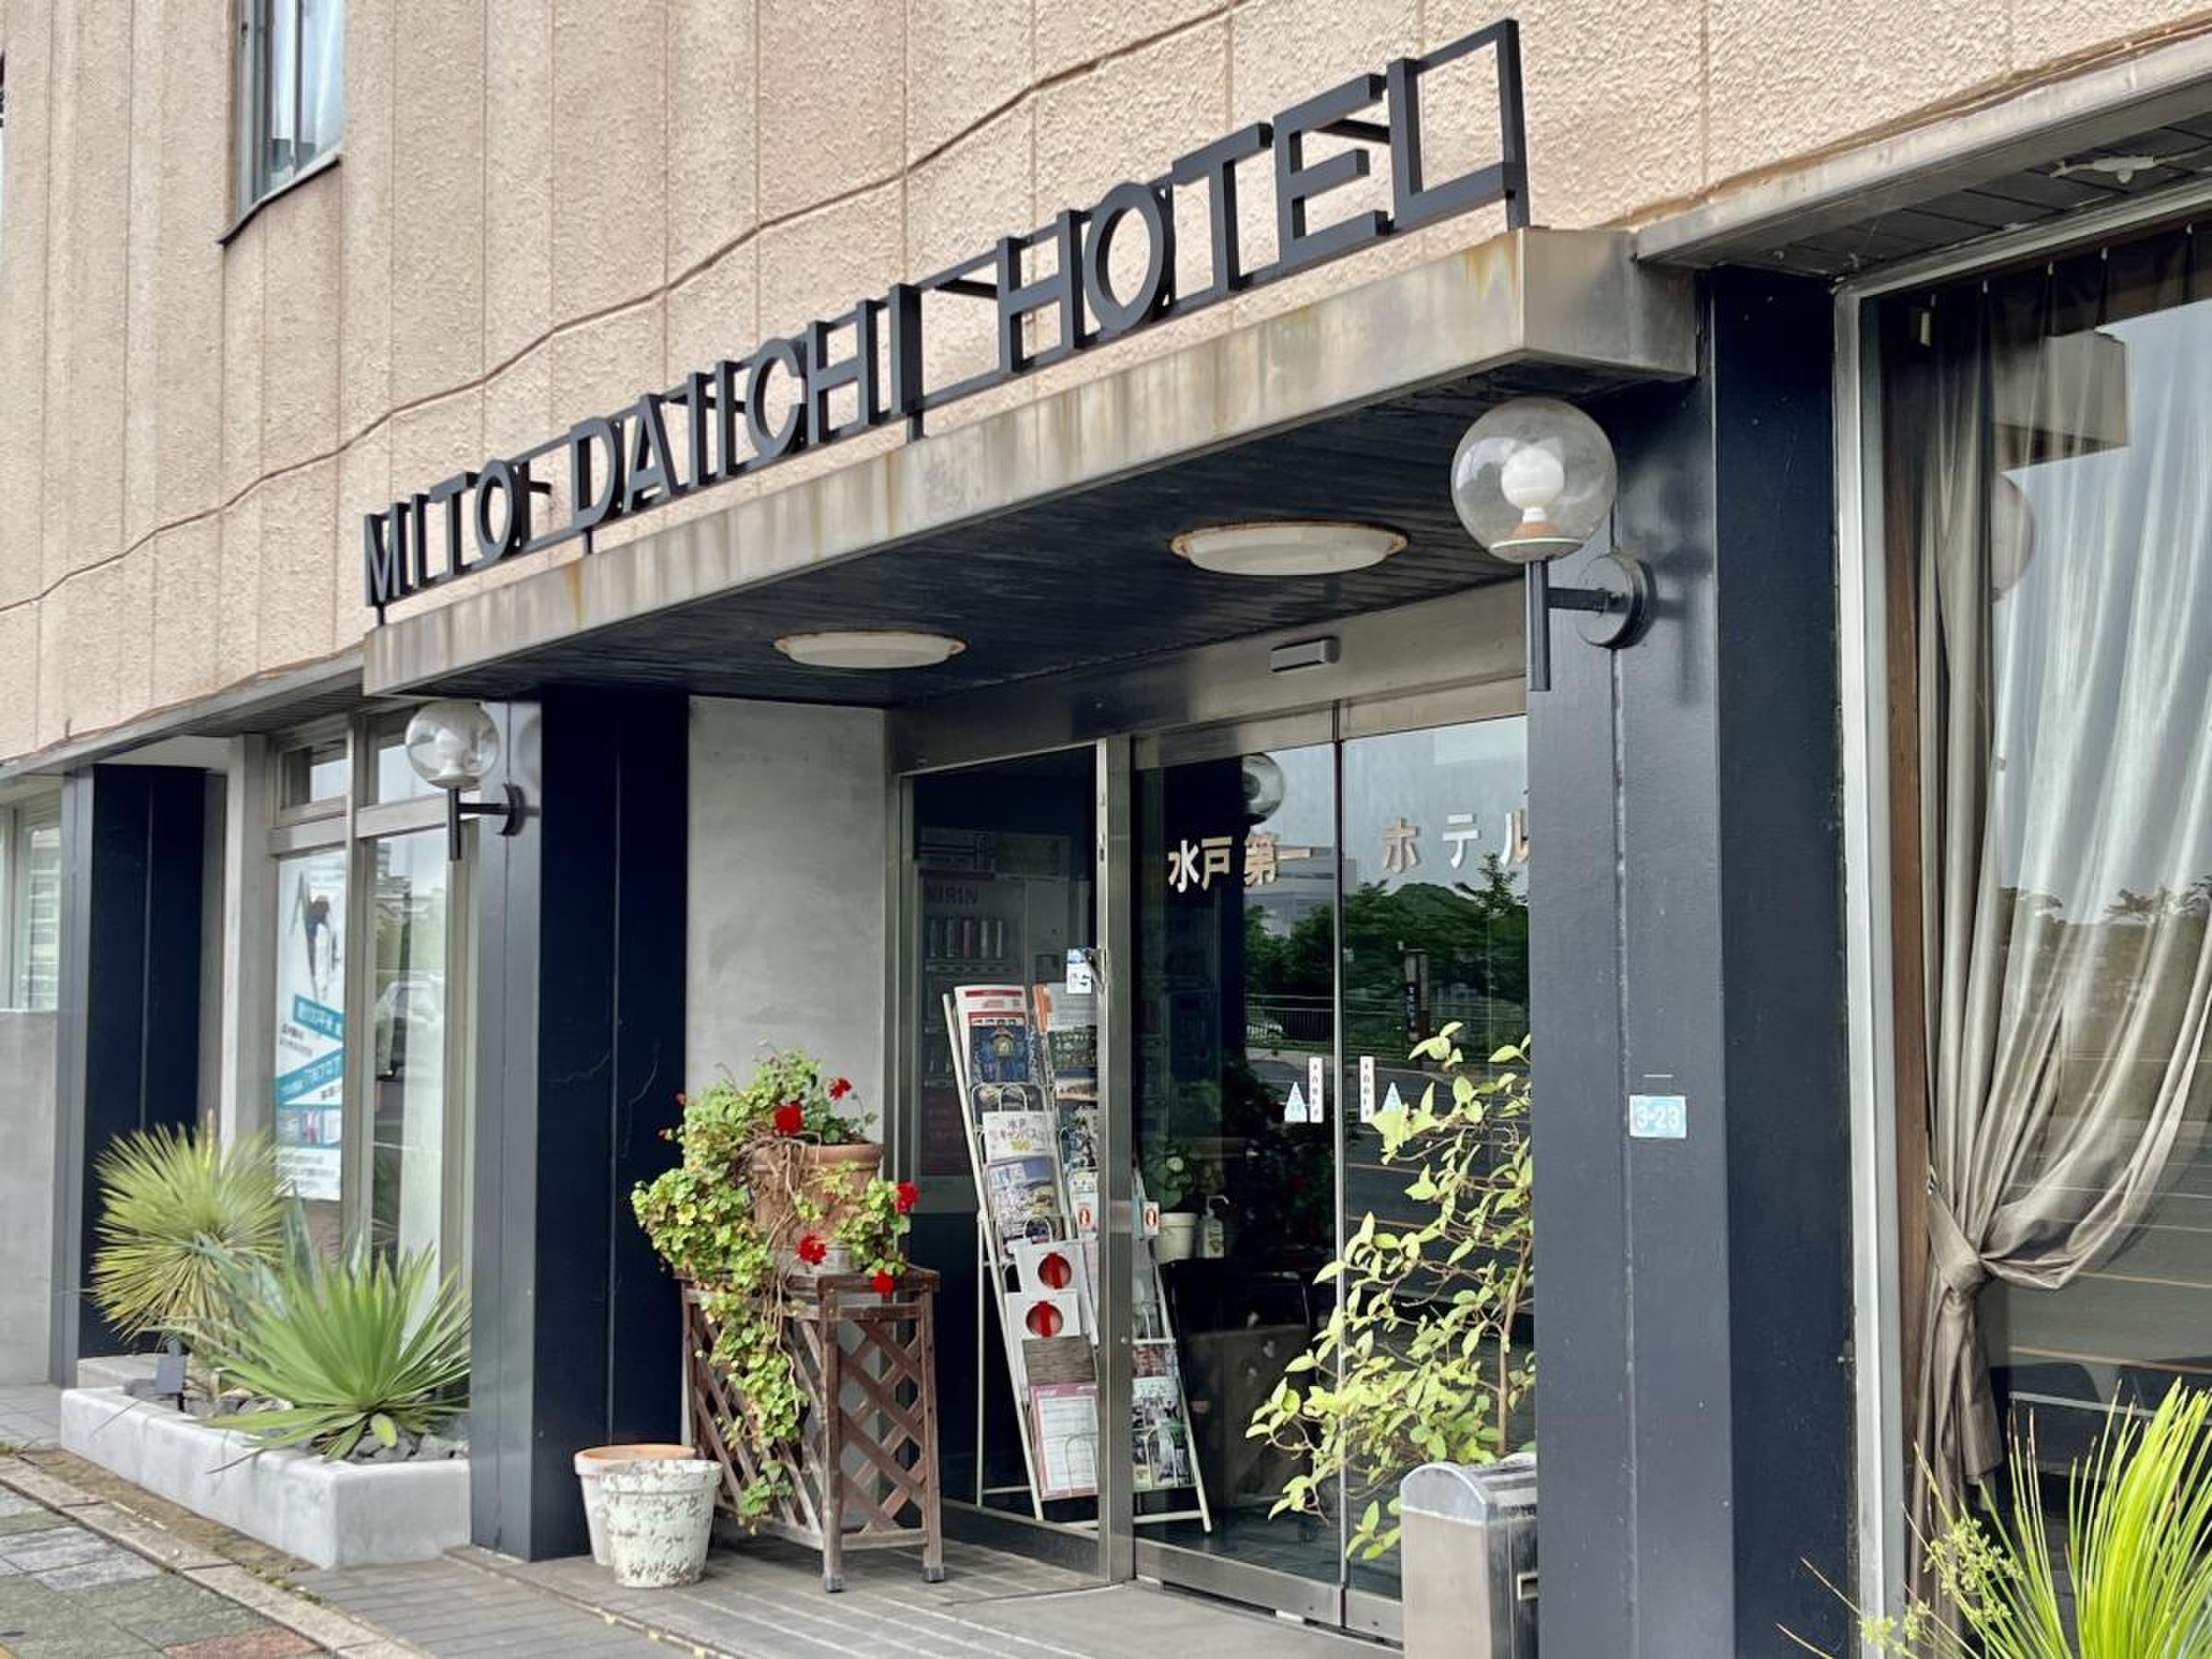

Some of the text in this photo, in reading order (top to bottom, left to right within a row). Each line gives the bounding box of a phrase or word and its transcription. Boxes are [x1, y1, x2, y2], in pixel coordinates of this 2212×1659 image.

[364, 57, 1506, 606] MITO DAIICHI HOTEL
[1168, 832, 1312, 893] 水戸第一
